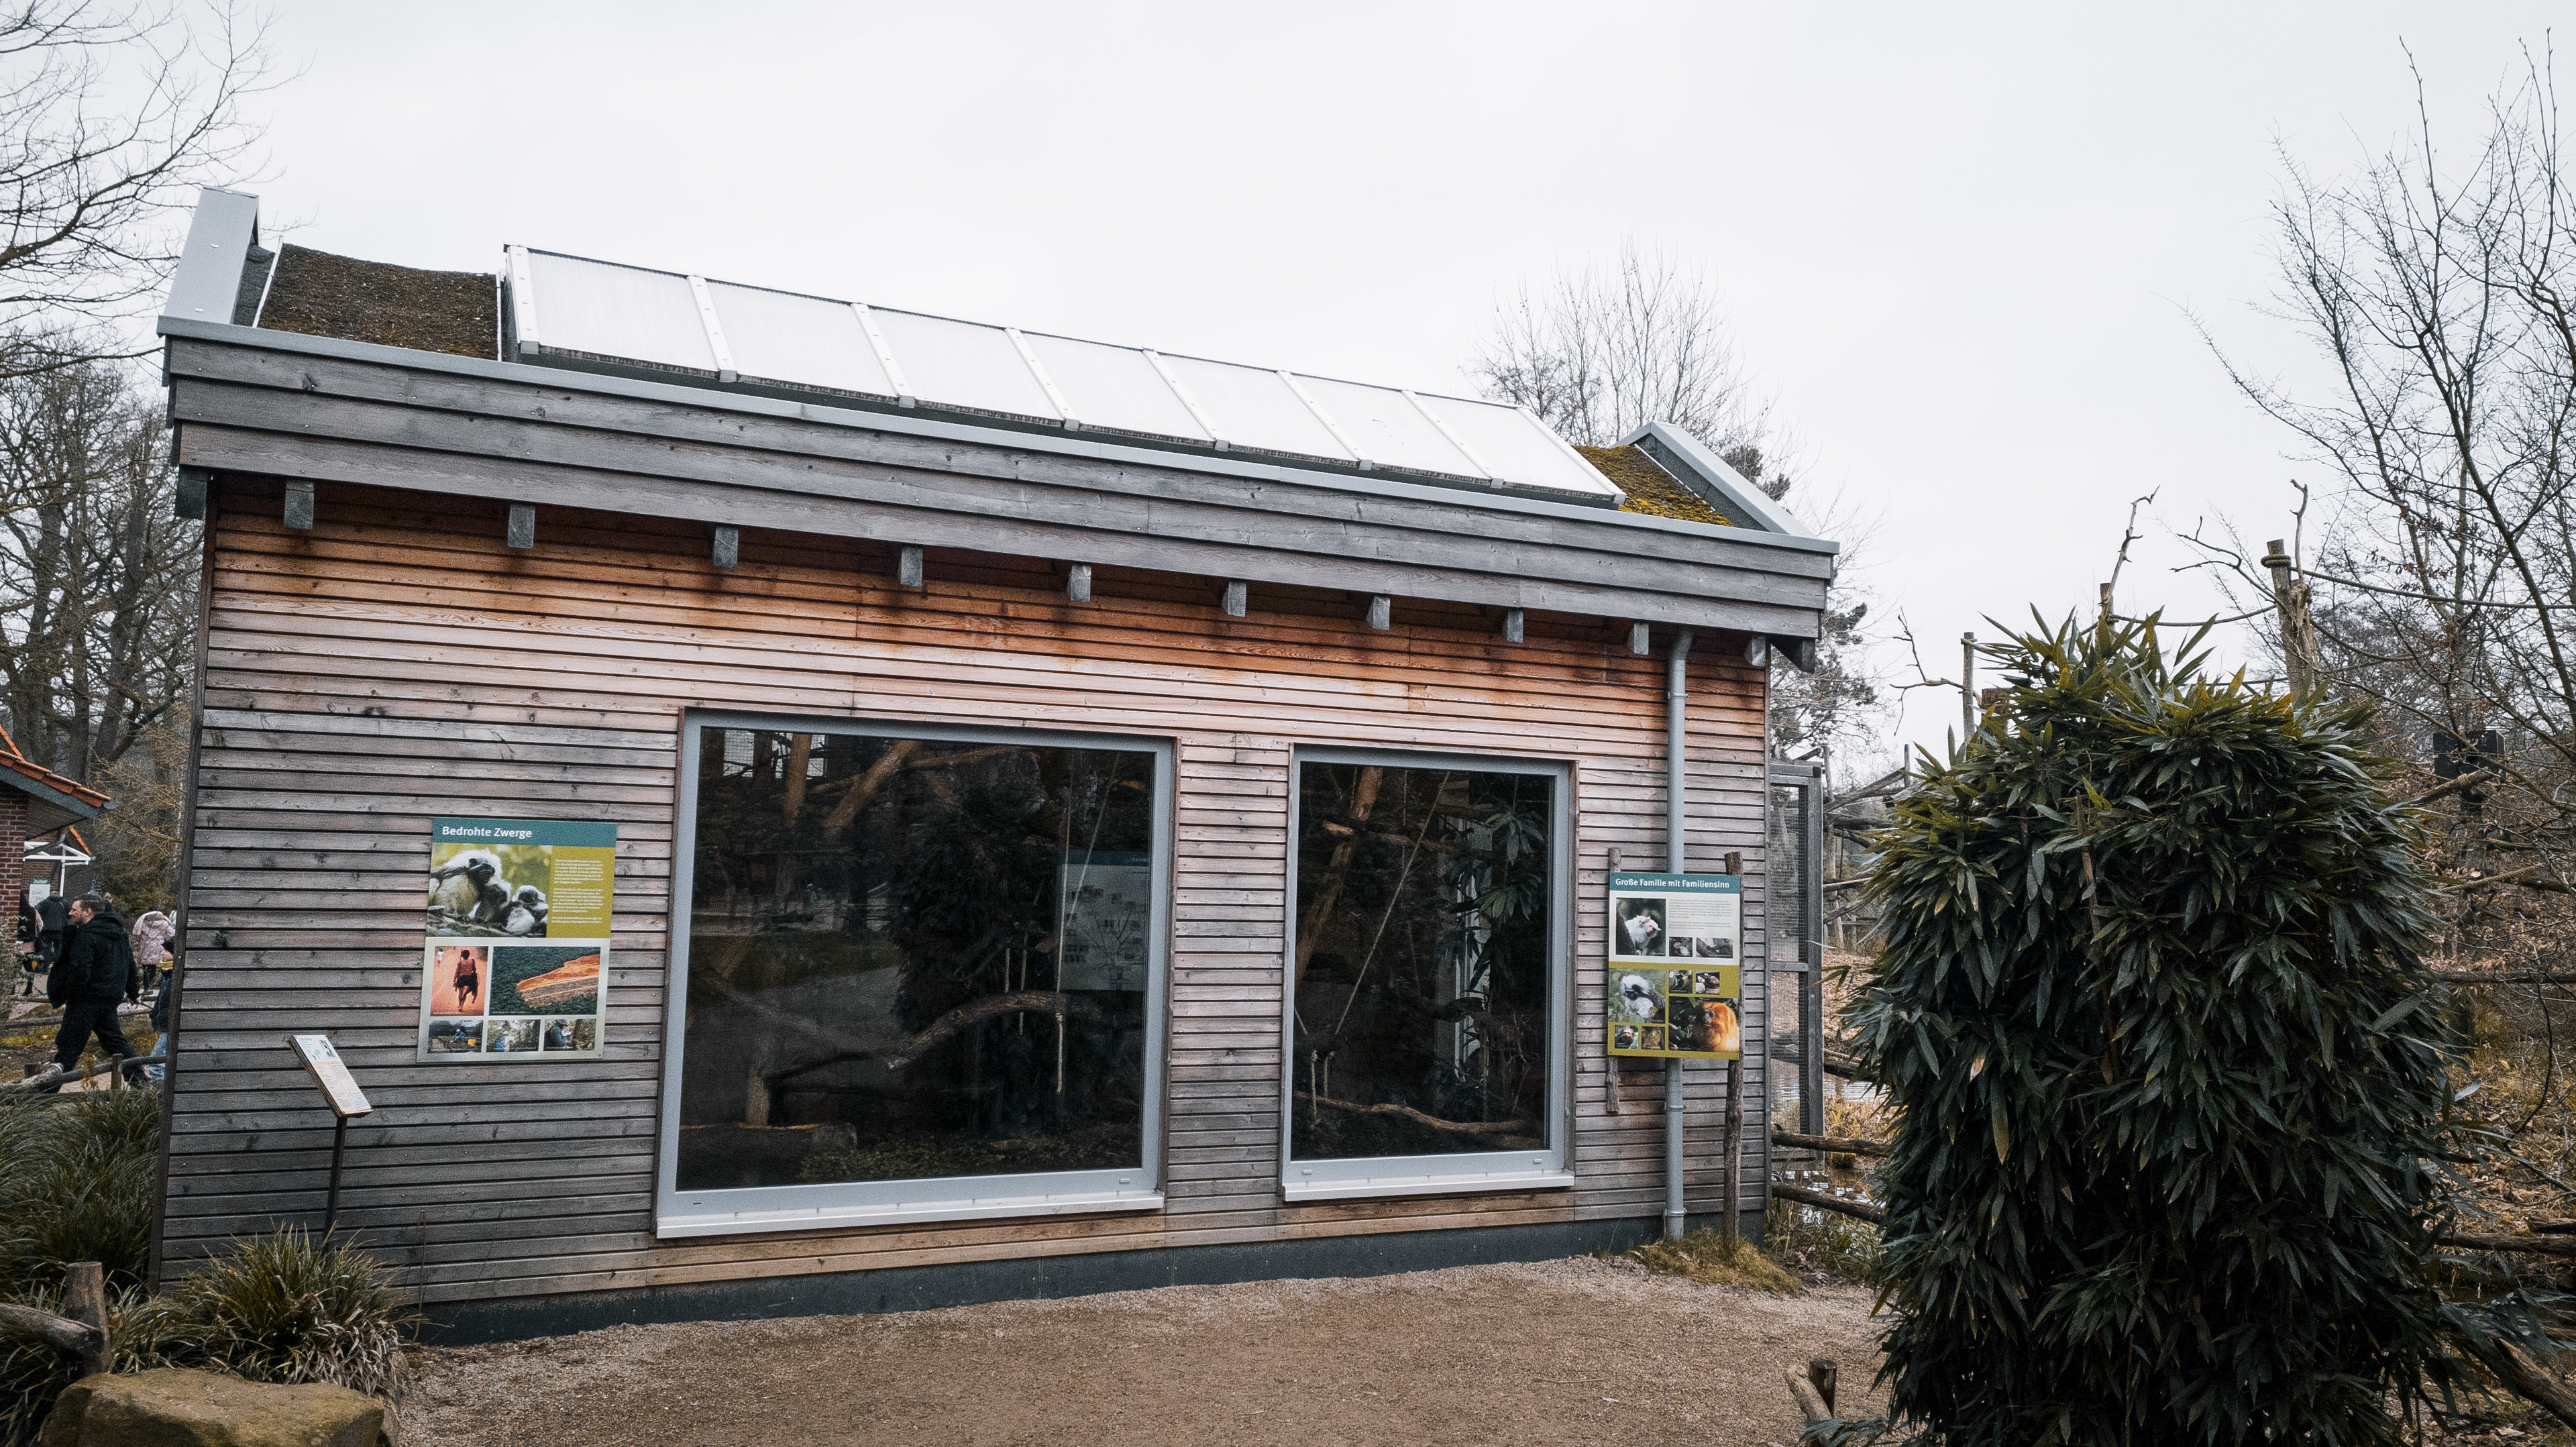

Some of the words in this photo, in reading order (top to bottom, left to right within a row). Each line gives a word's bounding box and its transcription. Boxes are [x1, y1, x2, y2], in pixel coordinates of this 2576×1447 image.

[442, 826, 492, 837] Bedrohte
[494, 827, 533, 839] Zwerge
[1615, 878, 1638, 886] Große
[1640, 879, 1666, 887] Familie
[1682, 880, 1729, 888] Familiensinn
